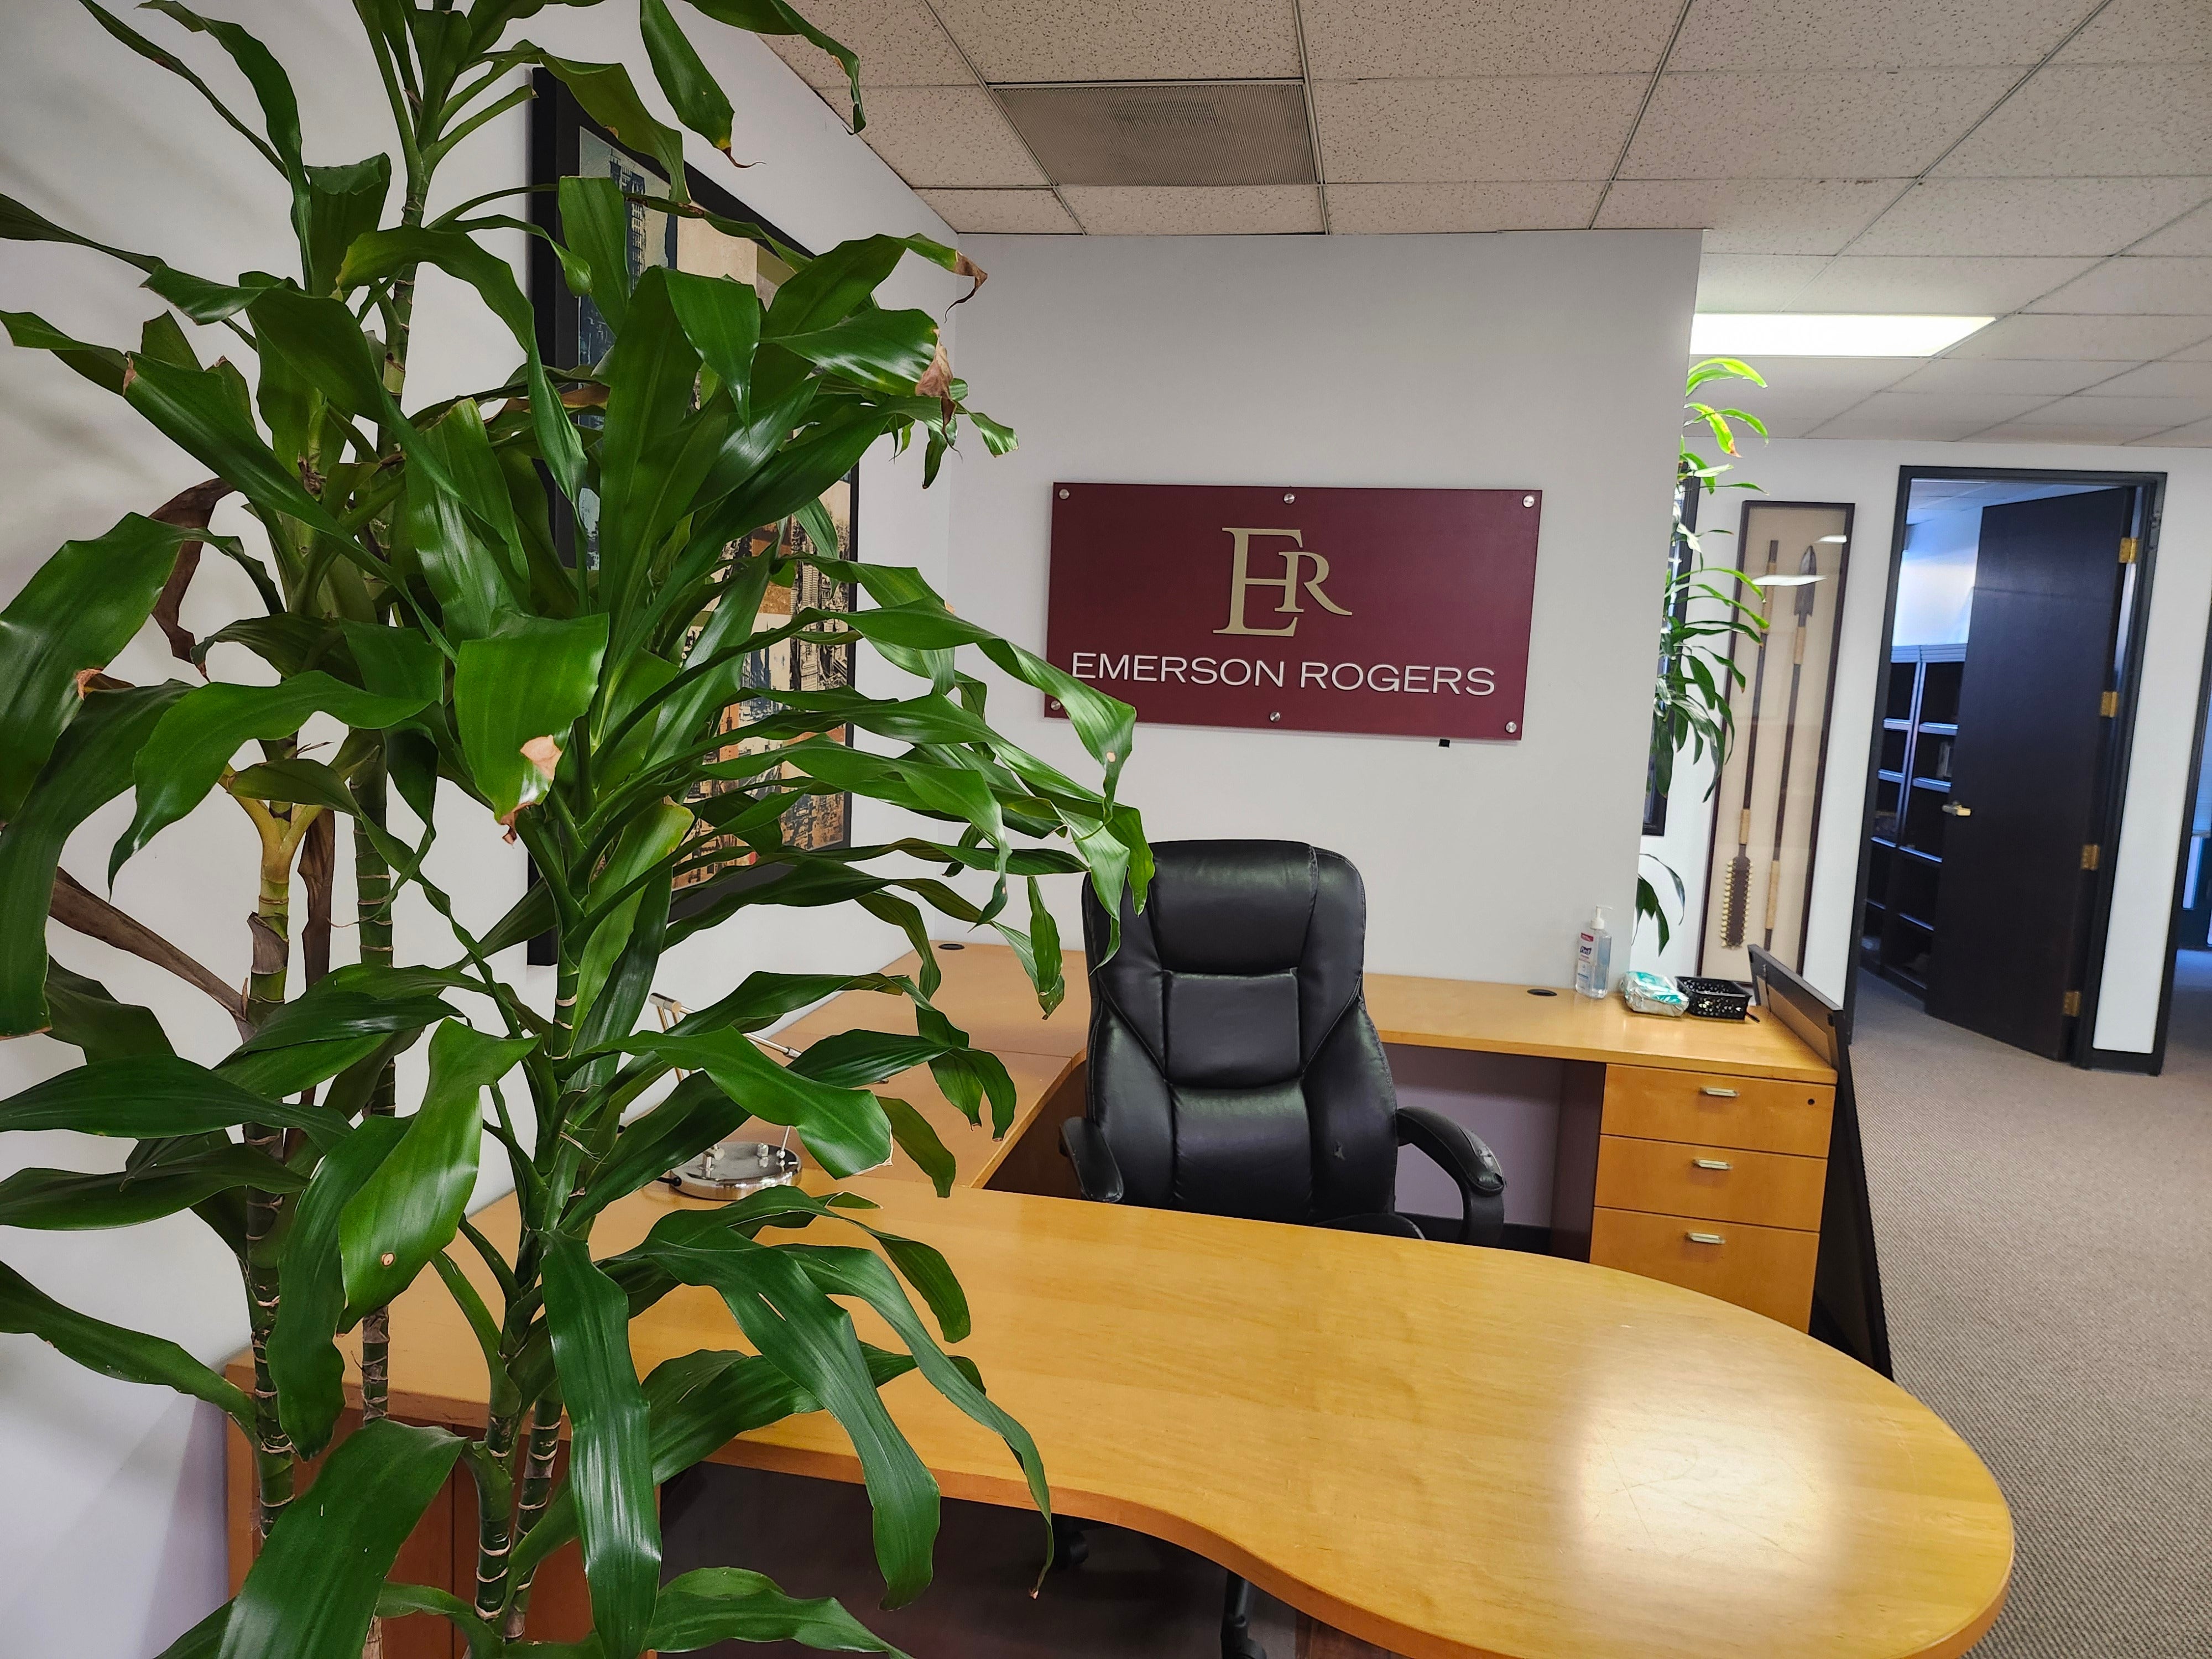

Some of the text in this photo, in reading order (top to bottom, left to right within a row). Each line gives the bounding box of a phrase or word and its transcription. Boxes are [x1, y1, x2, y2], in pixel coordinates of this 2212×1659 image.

[1213, 528, 1353, 637] ER
[1072, 652, 1495, 696] EMERSON ROGERS
